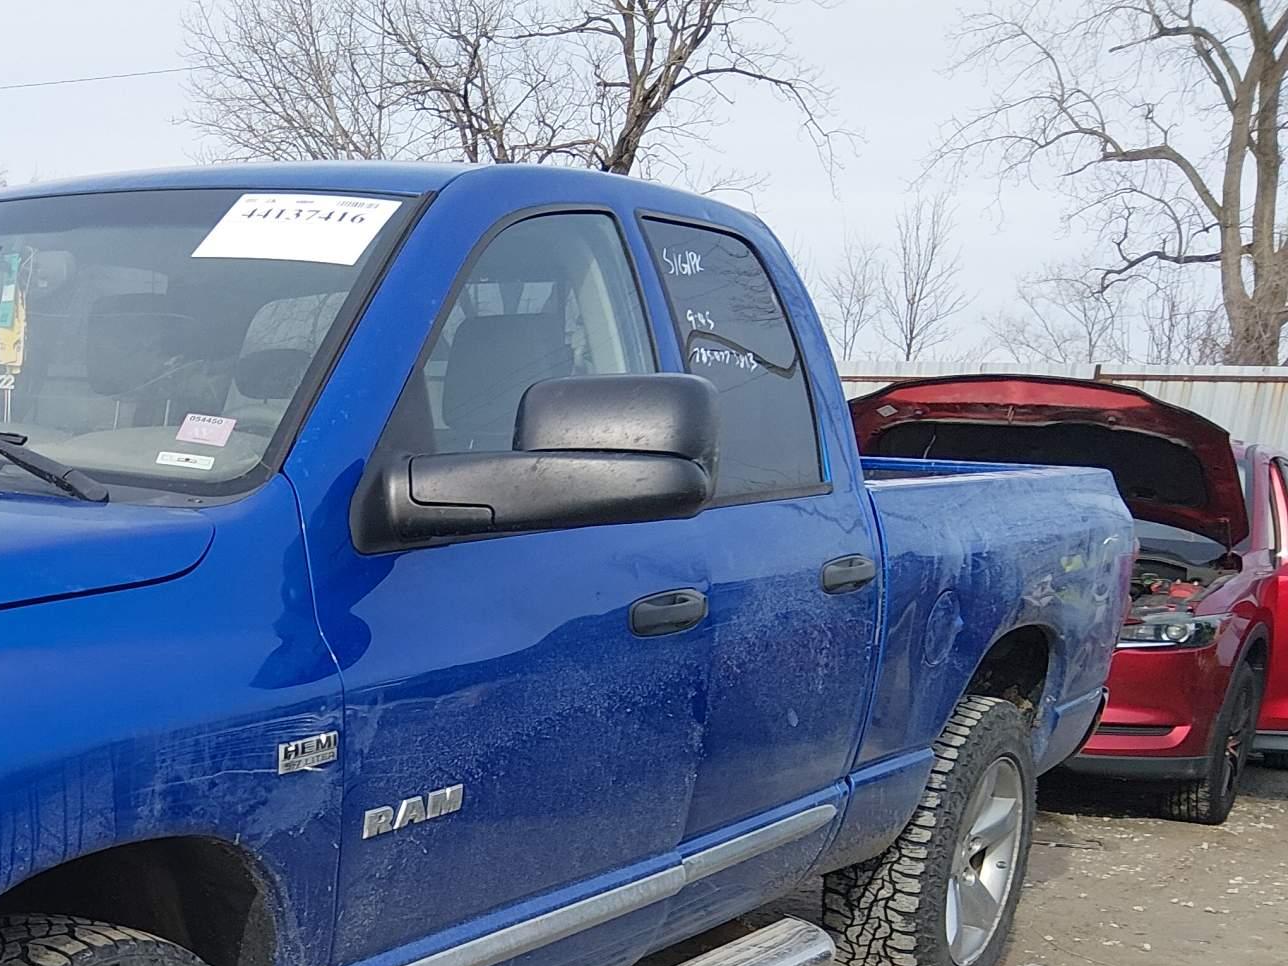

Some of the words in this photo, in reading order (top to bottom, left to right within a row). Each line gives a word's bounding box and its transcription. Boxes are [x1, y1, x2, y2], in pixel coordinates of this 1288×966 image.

[241, 207, 368, 224] 44137416
[189, 415, 224, 425] 054450
[283, 733, 337, 761] HEMI
[304, 751, 336, 766] LITER
[362, 783, 464, 840] RAM
